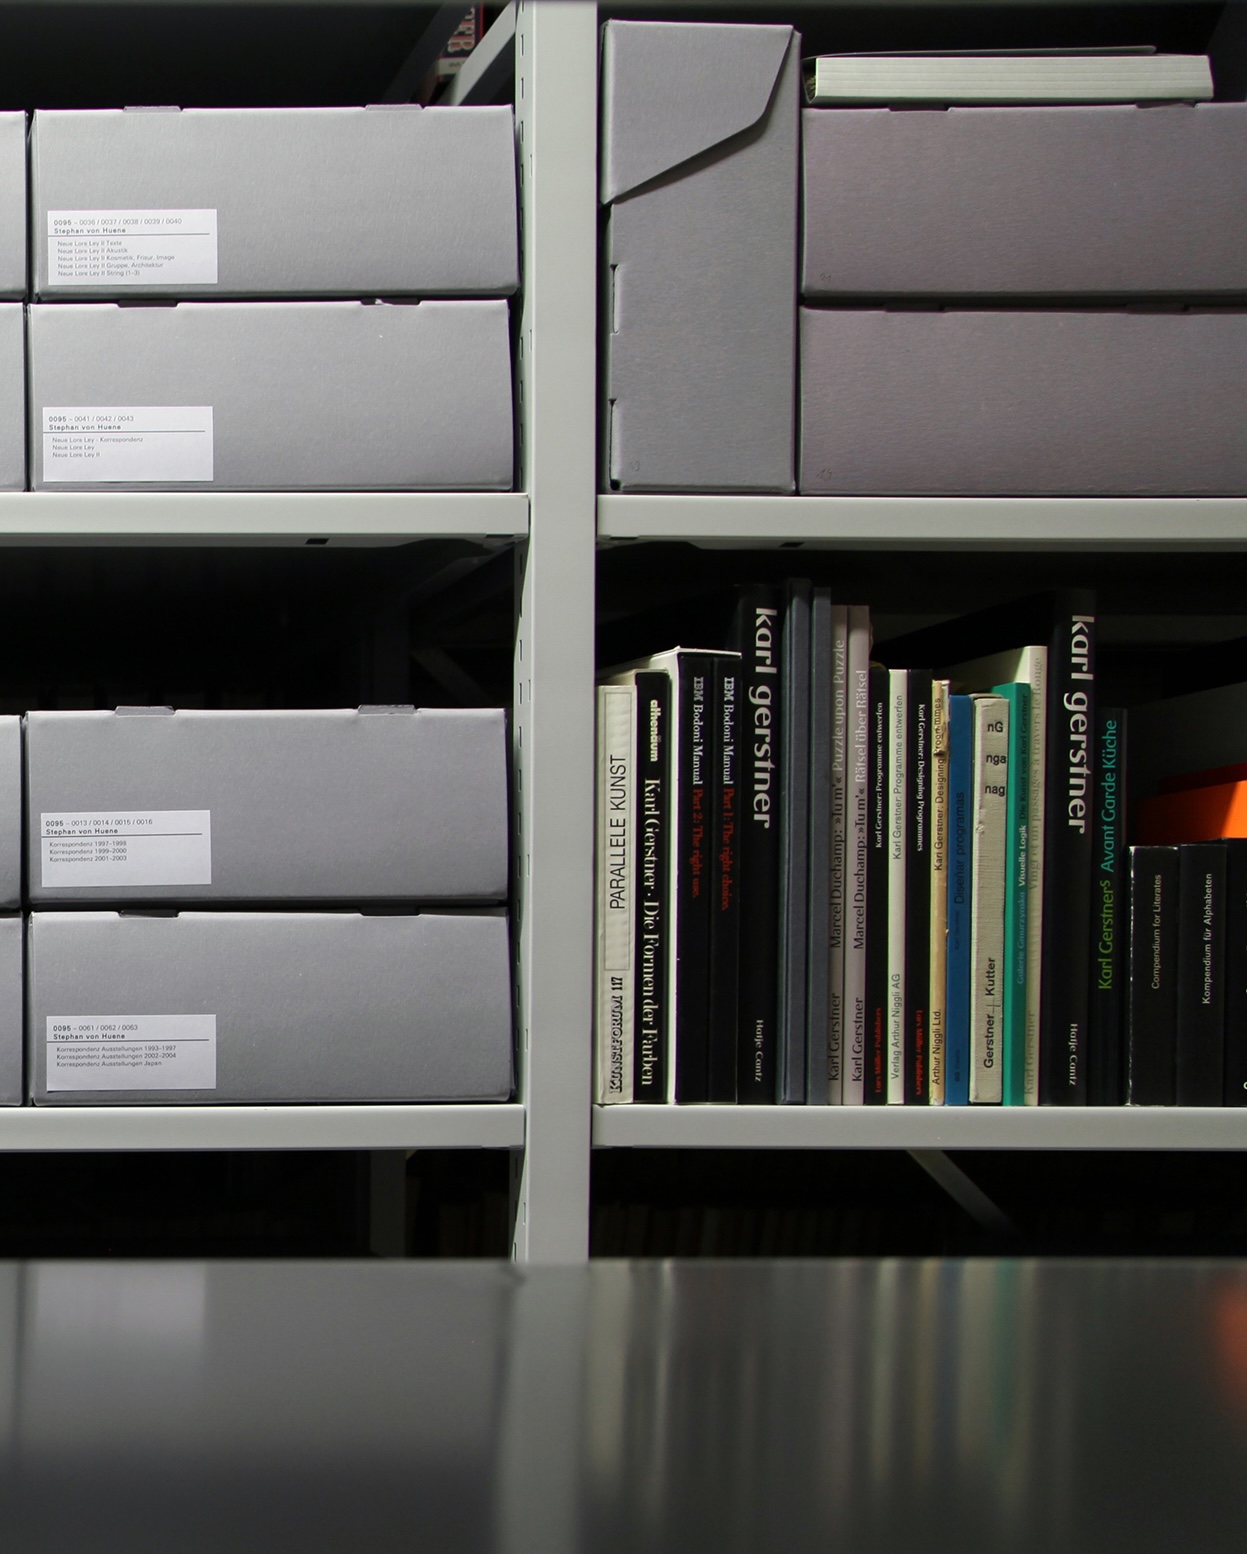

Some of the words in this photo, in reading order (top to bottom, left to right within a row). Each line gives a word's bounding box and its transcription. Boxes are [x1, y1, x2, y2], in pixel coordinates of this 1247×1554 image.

[756, 608, 776, 673] karl
[1071, 616, 1094, 679] karl
[832, 640, 844, 684] Puzzle
[693, 676, 704, 701] IBM
[724, 678, 734, 700] IBM
[834, 690, 845, 724] upon
[856, 669, 867, 709] Rätsel
[649, 698, 661, 763] athenäum
[694, 705, 703, 742] Bodoni
[724, 705, 734, 741] Bodoni
[855, 711, 866, 743] über
[895, 695, 903, 739] entwerfen
[986, 720, 1004, 734] nG
[749, 686, 775, 828] gerstner
[832, 727, 843, 771] Puzzle
[855, 744, 866, 784] Rätsel
[985, 754, 1006, 766] nga
[1064, 692, 1091, 833] gerstner
[1102, 720, 1116, 768] Küche
[610, 755, 626, 810] KUNST
[693, 746, 703, 784] Manual
[724, 746, 733, 784] Manual
[894, 742, 904, 793] Programme
[935, 758, 946, 804] Designing
[645, 780, 660, 814] Karl
[984, 784, 1006, 797] nag
[1102, 773, 1115, 821] Garde
[893, 796, 901, 839] Gerstner:
[934, 807, 942, 849] Gerstner:
[610, 819, 625, 908] PARALLELE
[645, 819, 659, 889] Gerstner
[831, 829, 844, 900] Duchamp:
[854, 835, 867, 904] Duchamp:
[893, 842, 901, 860] Karl
[934, 852, 942, 870] Karl
[1101, 826, 1114, 872] Avant
[644, 902, 659, 929] Die
[1204, 874, 1213, 925] Alphabeten
[831, 902, 841, 948] Marcel
[854, 905, 864, 951] Marcel
[1203, 928, 1211, 940] für
[643, 935, 658, 995] Formen
[985, 958, 995, 997] Kutter
[1098, 959, 1112, 988] Karl
[1152, 930, 1160, 989] Compendium
[1202, 944, 1212, 1003] Kompendium
[611, 977, 622, 990] 117
[892, 973, 900, 990] AG
[643, 1000, 658, 1024] der
[829, 993, 840, 1052] Gerstner
[852, 998, 863, 1053] Gerstner
[892, 992, 902, 1018] Niggli
[610, 996, 622, 1093] KUNSTFORUM
[755, 1020, 763, 1047] Hatje
[932, 1030, 943, 1056] Niggli
[984, 1014, 994, 1068] Gerstner
[1069, 1024, 1077, 1051] Hatje
[642, 1030, 657, 1084] Farben
[829, 1055, 839, 1081] Karl
[852, 1054, 862, 1083] Karl
[891, 1051, 902, 1079] Verlag
[932, 1059, 940, 1085] Arthur
